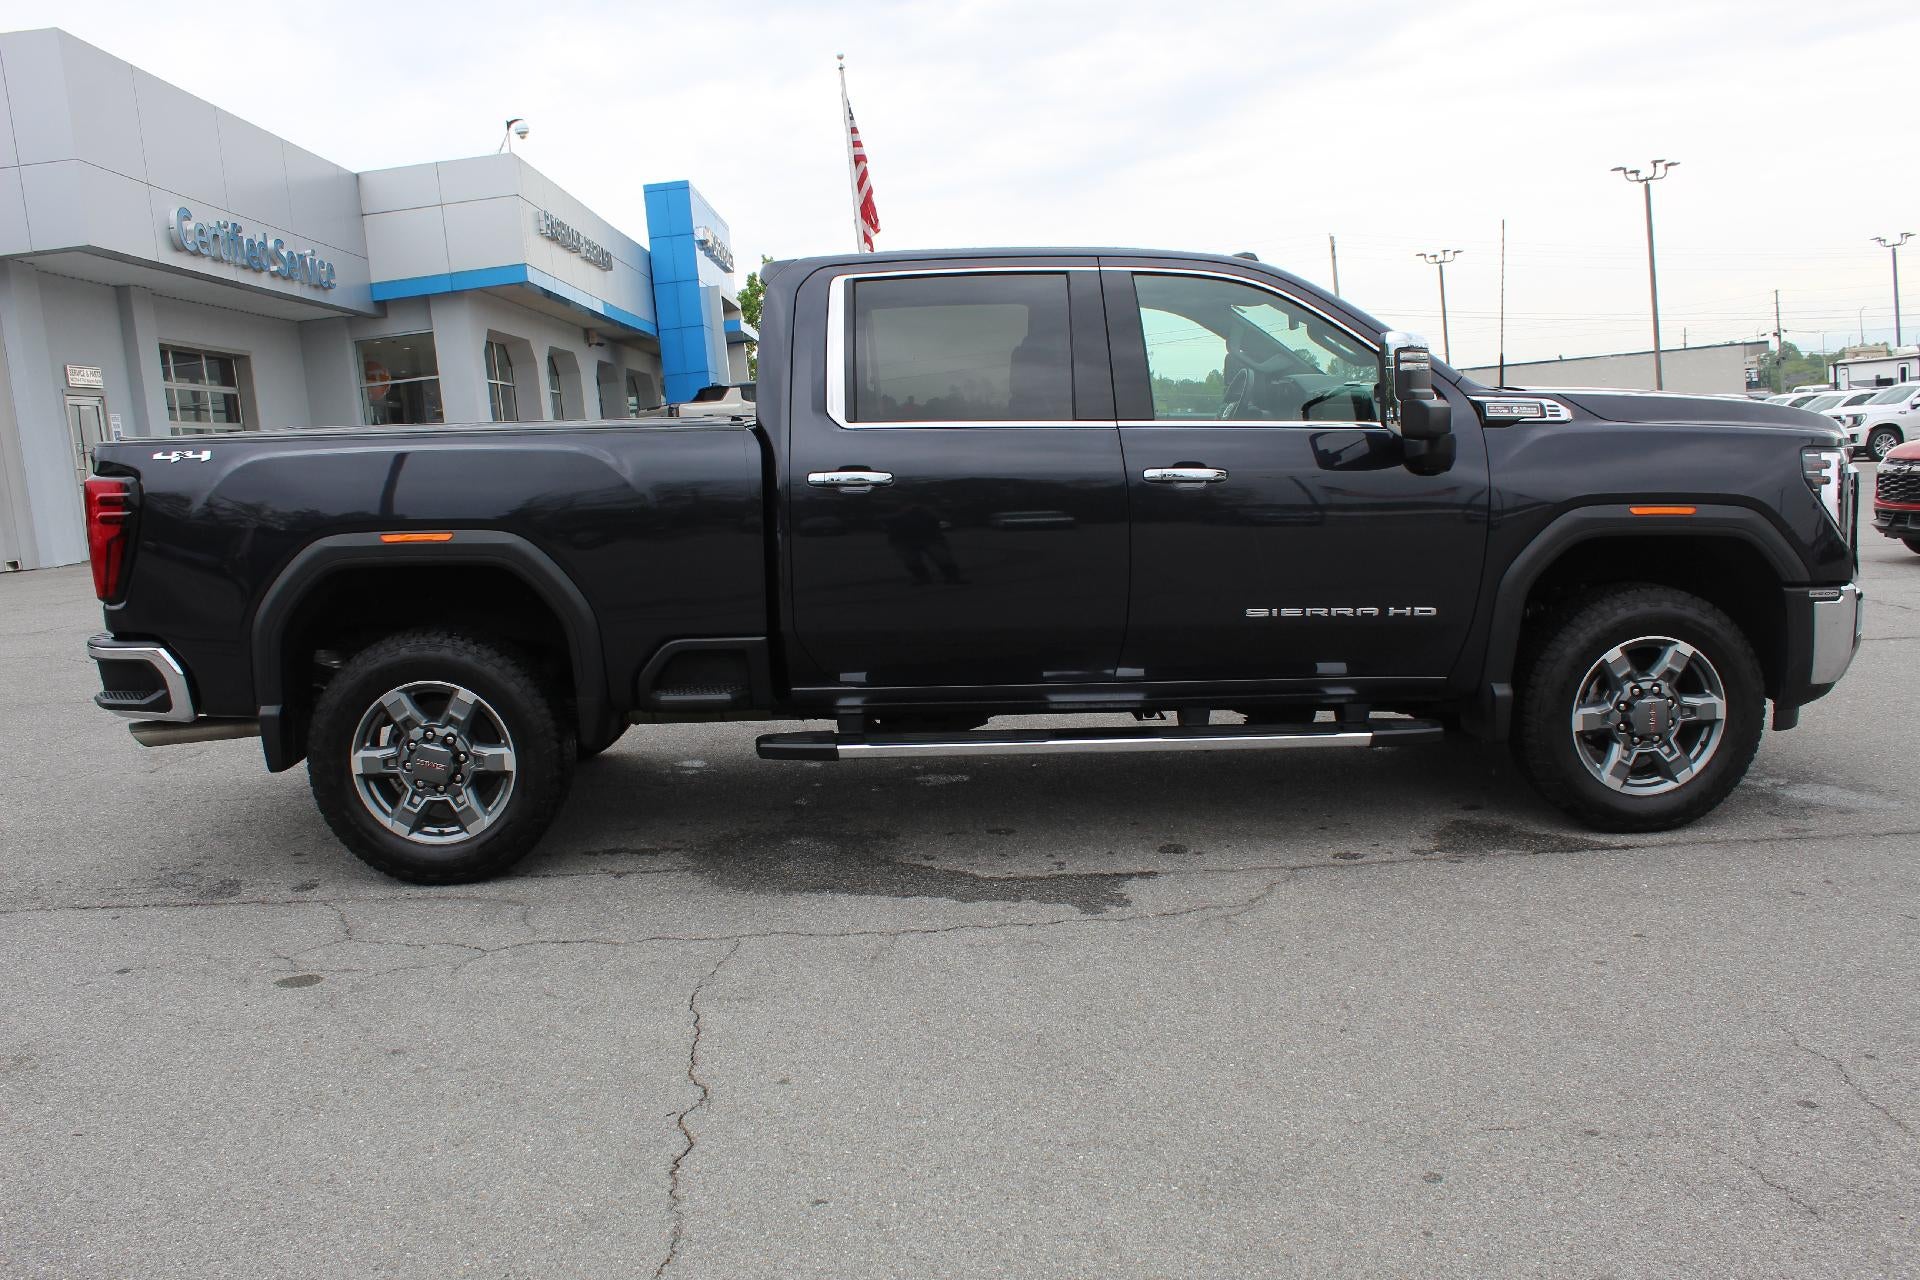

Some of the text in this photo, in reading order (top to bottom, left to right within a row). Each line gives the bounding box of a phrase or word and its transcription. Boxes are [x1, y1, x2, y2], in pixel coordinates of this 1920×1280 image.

[171, 206, 337, 289] Certified Service
[1245, 606, 1437, 617] SIERRA HD
